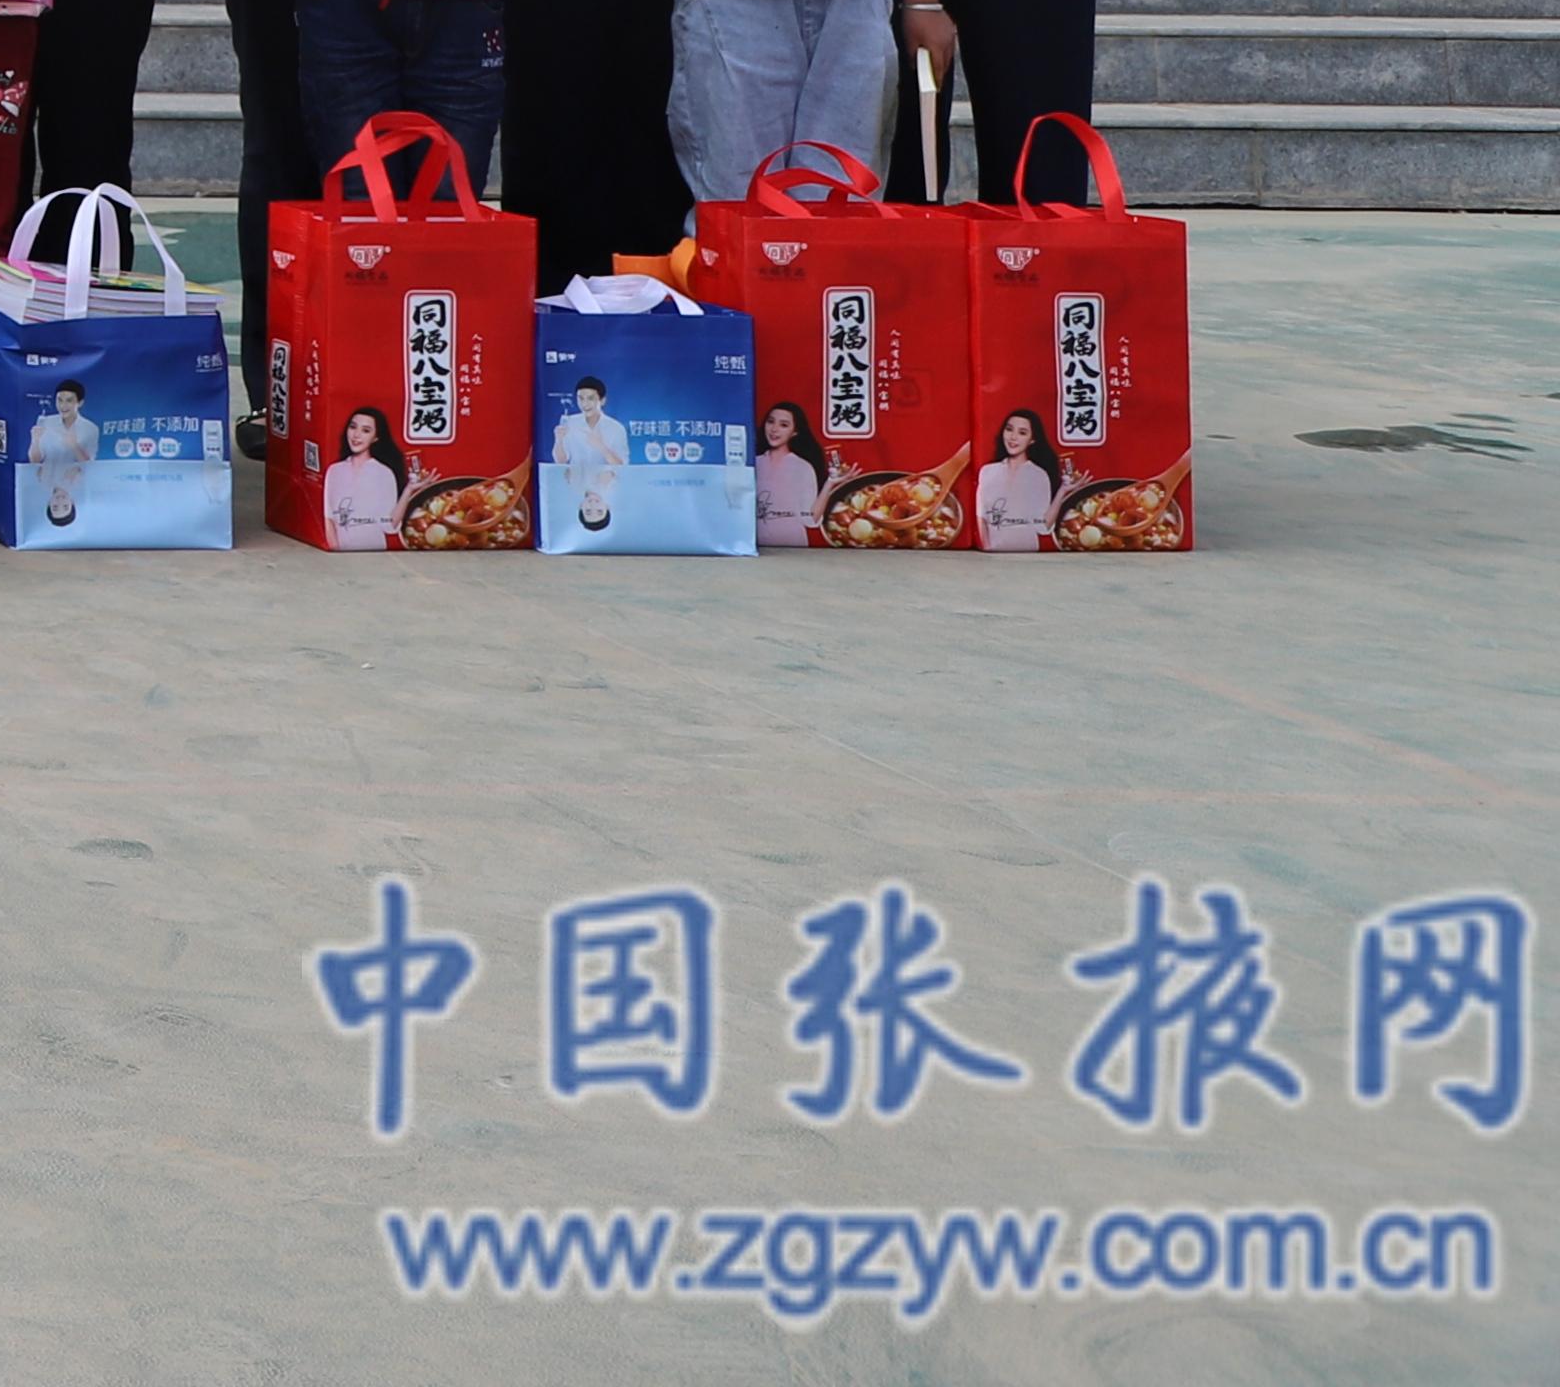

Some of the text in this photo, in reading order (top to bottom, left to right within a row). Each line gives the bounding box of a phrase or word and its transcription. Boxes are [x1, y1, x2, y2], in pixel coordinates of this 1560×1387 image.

[271, 346, 287, 434] 同福八宝粥
[409, 299, 452, 435] 同福八宝粥
[829, 295, 870, 430] 同福八宝粥
[1060, 301, 1101, 437] 同福八宝粥
[103, 416, 199, 435] 好味道 不添加
[628, 420, 721, 437] 好味道 不添加
